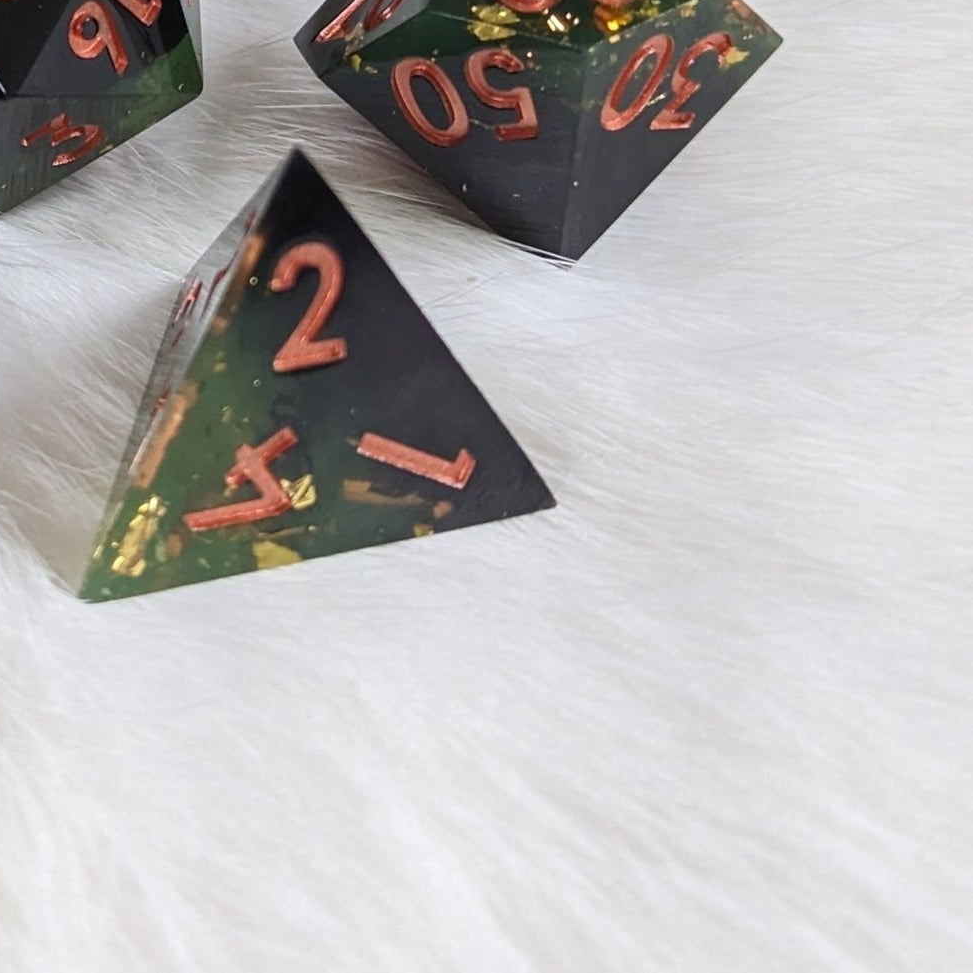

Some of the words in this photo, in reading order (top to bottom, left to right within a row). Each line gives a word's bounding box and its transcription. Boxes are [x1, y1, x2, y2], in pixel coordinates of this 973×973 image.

[390, 48, 540, 148] 50
[600, 32, 733, 132] 30
[270, 240, 348, 373] 2
[182, 426, 299, 532] 4
[356, 432, 477, 490] 1
